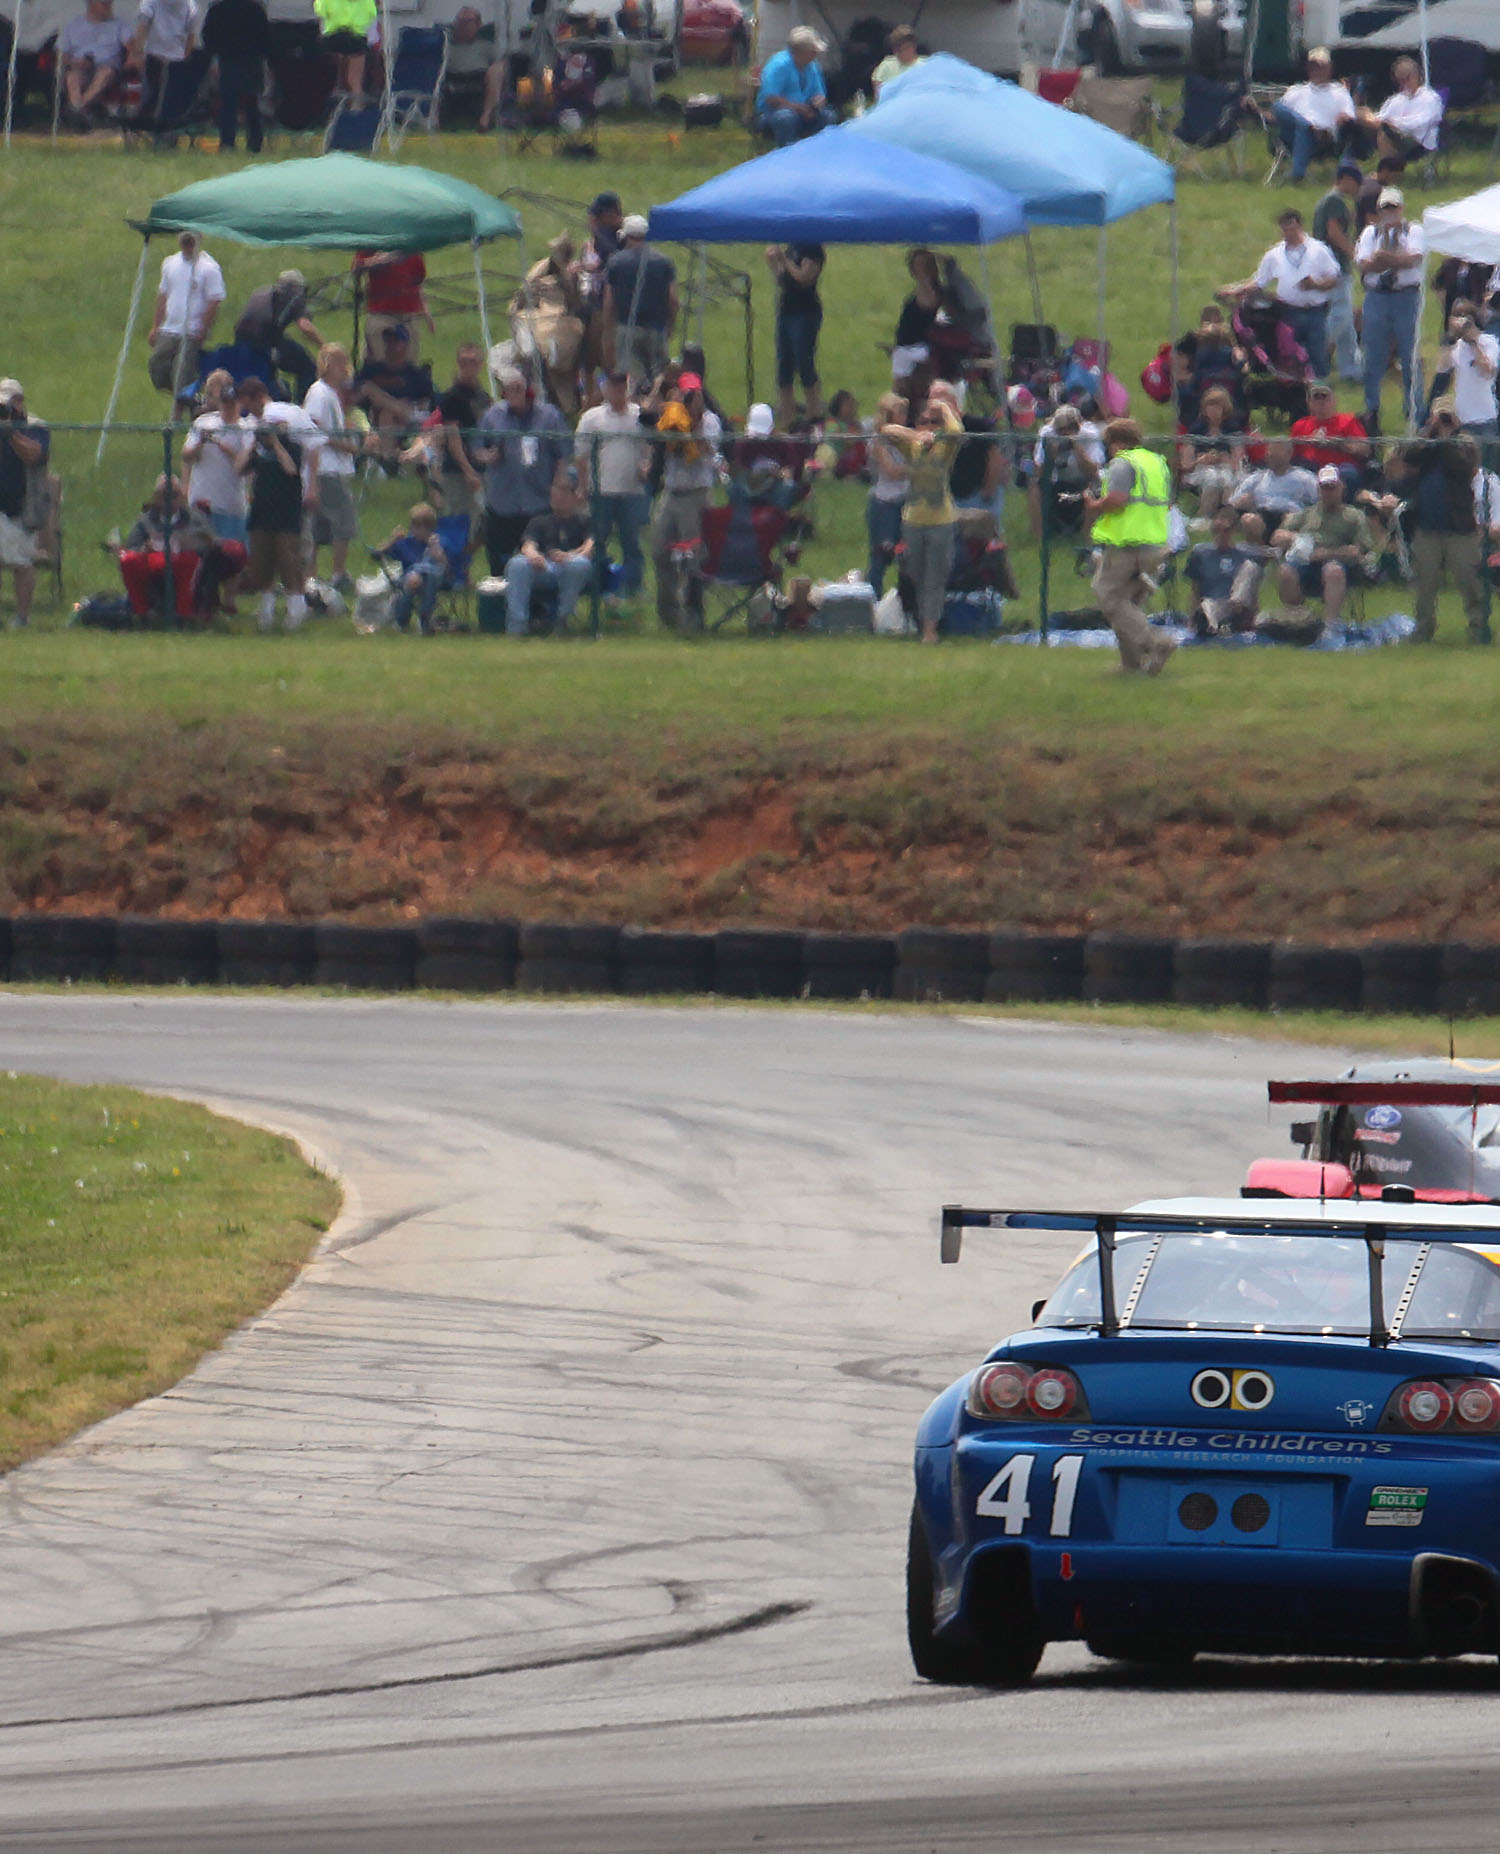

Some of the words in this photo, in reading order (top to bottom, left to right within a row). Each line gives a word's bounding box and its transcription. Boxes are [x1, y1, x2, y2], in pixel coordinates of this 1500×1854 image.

[1069, 1428, 1198, 1448] Seattle
[1208, 1434, 1393, 1454] Children's
[1088, 1448, 1159, 1460] HOSPITAL
[1172, 1451, 1251, 1463] RESEARCH
[1264, 1453, 1366, 1465] FOUNDATION
[976, 1454, 1084, 1537] 41
[1378, 1495, 1418, 1506] ROLEX
